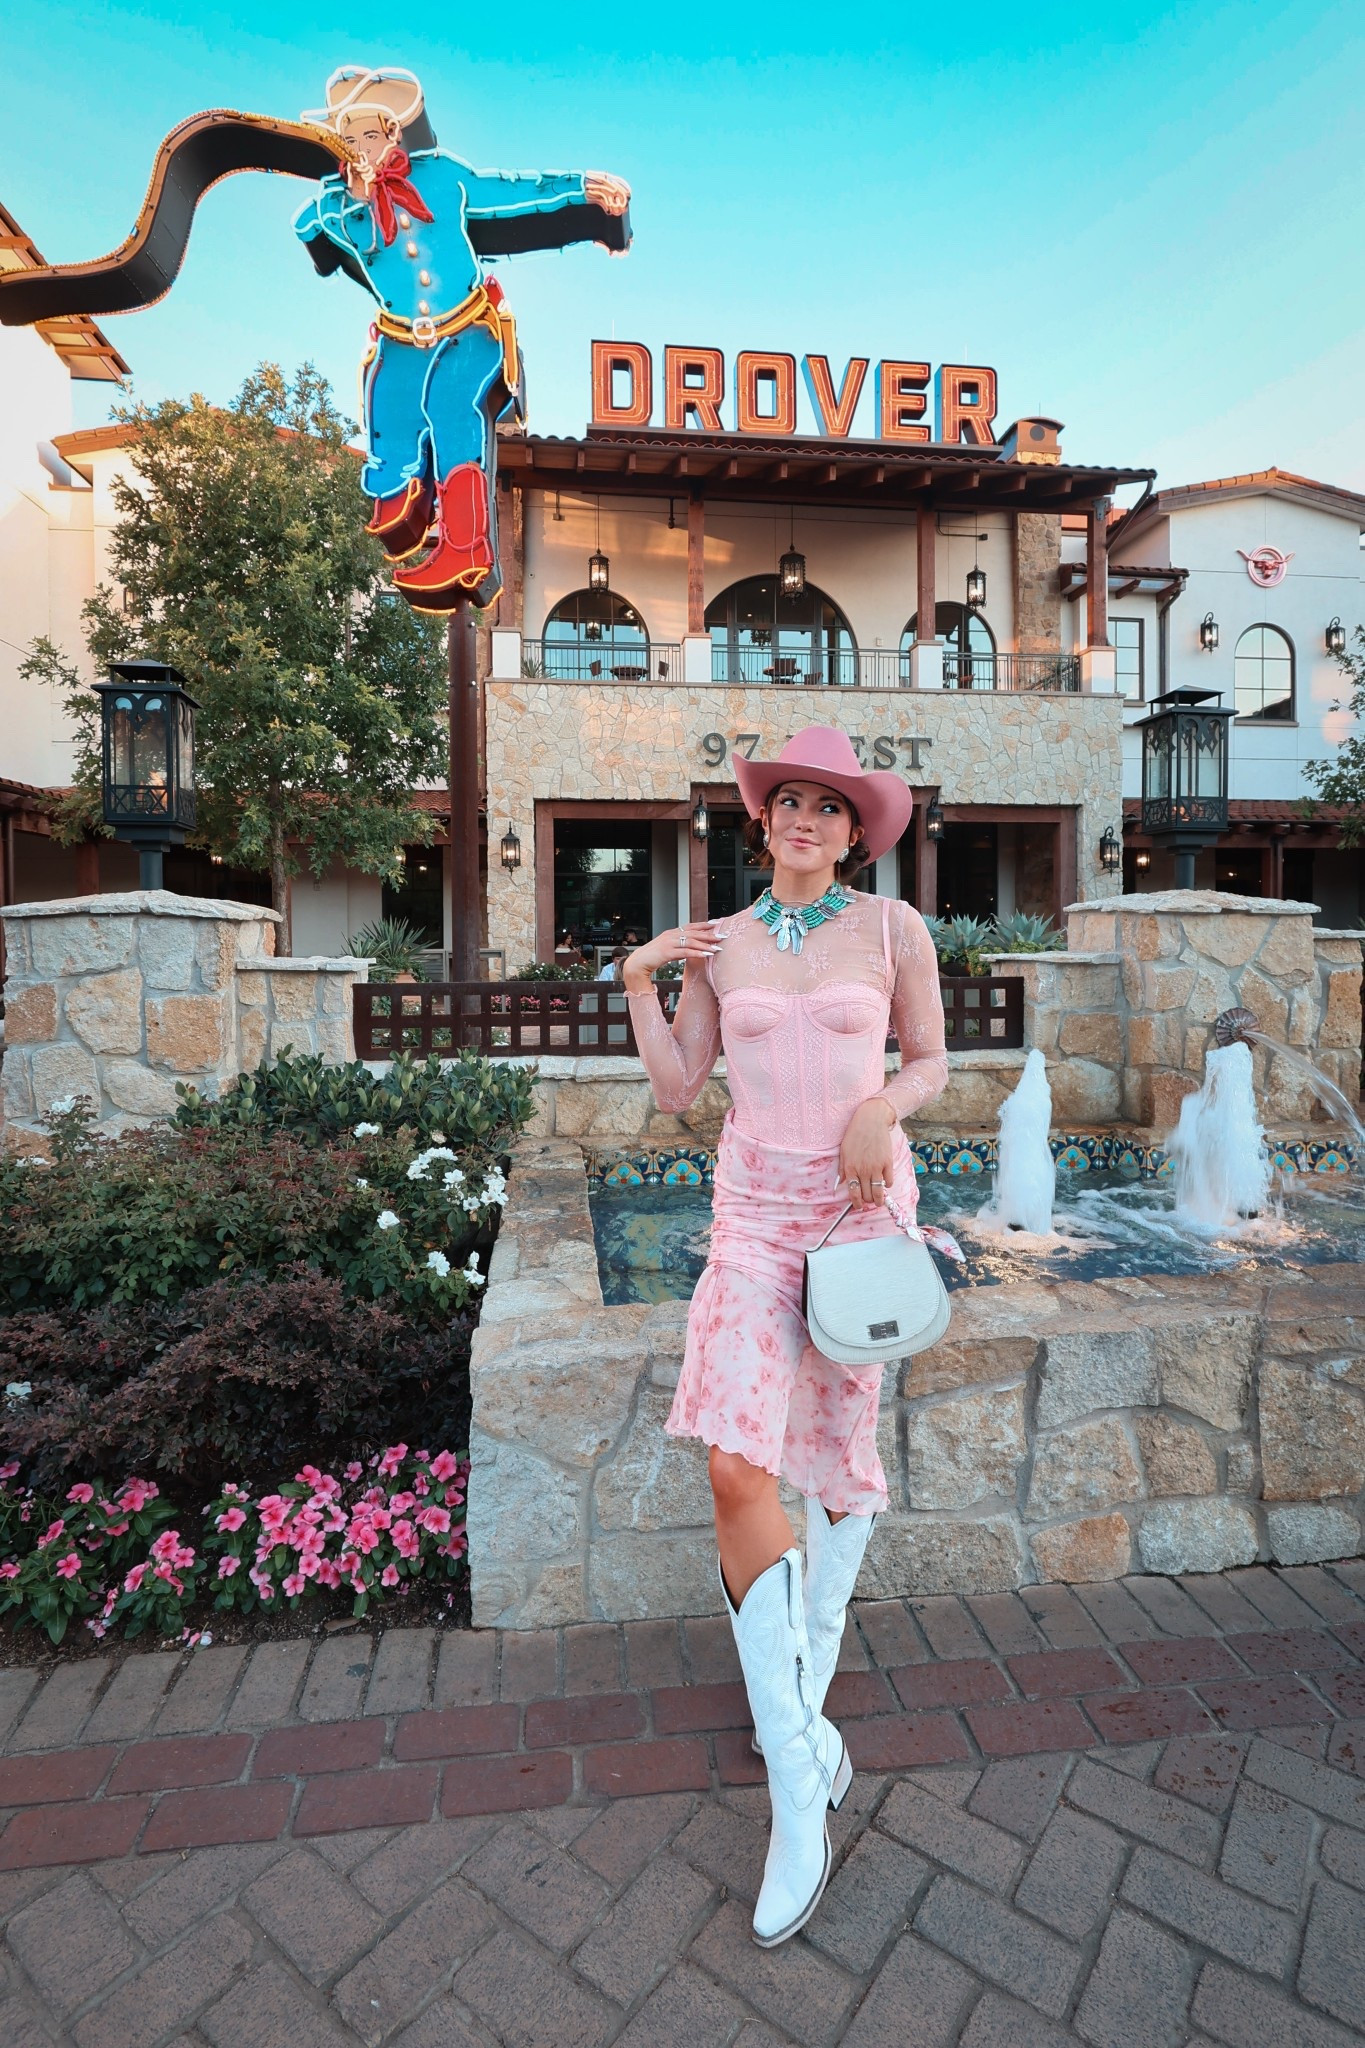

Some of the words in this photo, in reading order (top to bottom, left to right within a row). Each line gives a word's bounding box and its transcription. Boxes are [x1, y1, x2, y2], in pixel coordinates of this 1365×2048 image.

[591, 339, 997, 446] DROVER
[703, 732, 760, 767] 97
[785, 734, 932, 769] EST
